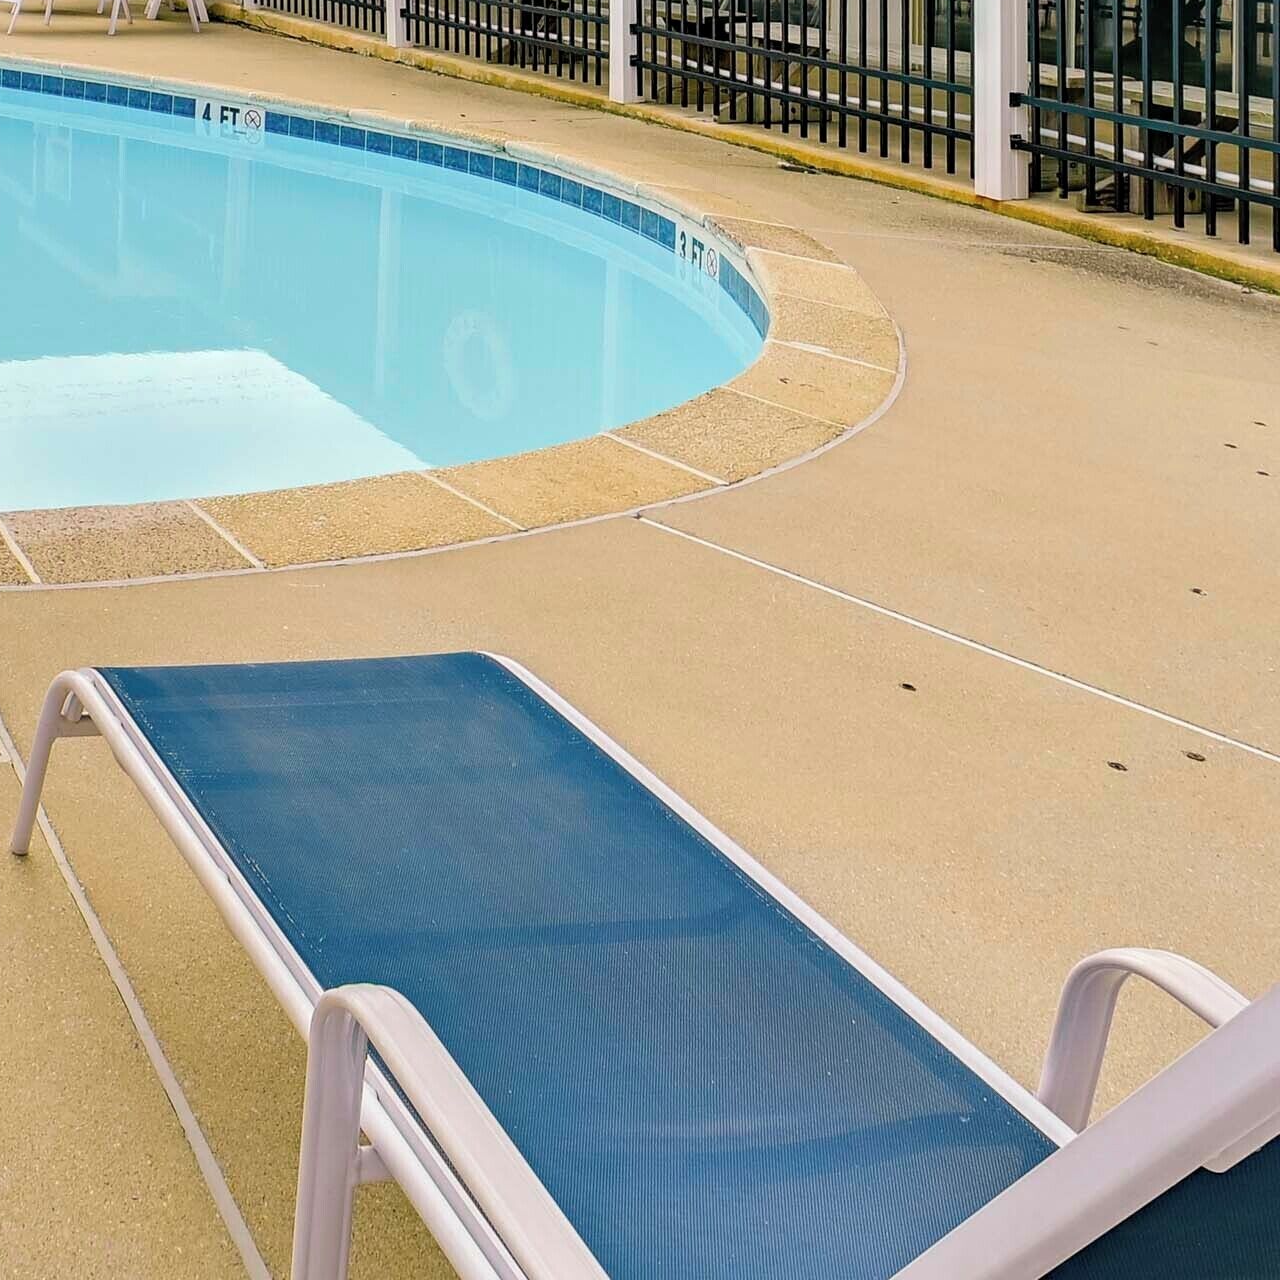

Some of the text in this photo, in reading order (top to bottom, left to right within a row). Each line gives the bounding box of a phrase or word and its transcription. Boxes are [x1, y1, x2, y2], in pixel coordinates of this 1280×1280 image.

[202, 102, 240, 126] 4 FT
[679, 230, 705, 271] 3 FT
